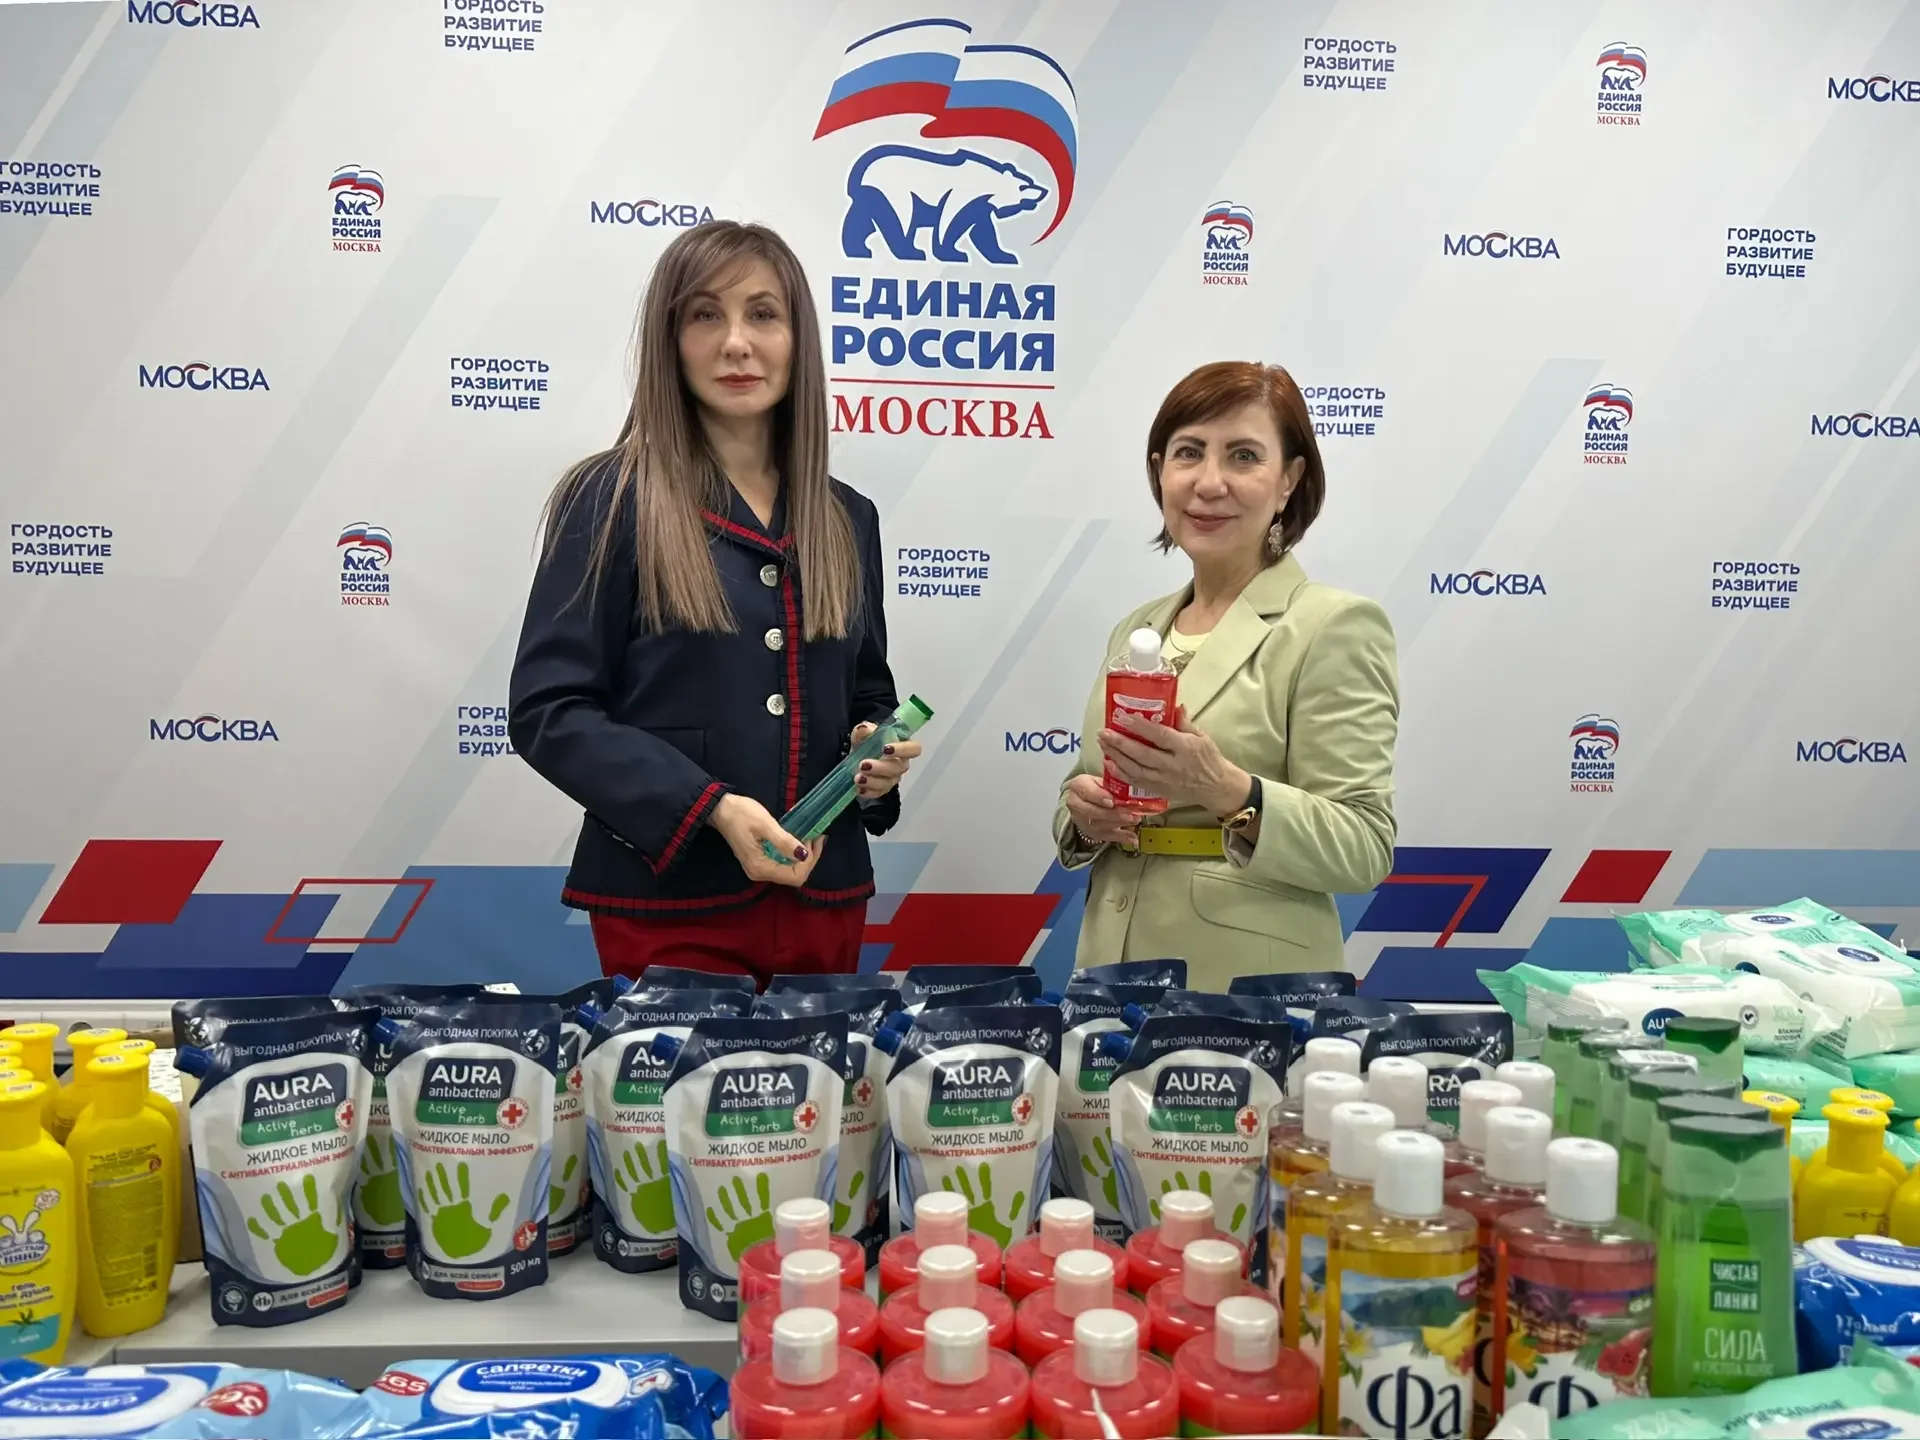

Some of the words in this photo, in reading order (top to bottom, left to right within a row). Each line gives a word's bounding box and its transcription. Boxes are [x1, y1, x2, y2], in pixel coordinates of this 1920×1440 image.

[127, 0, 261, 29] МОСКВА
[444, 15, 543, 33] РАЗВИТИЕ
[444, 34, 535, 53] БУДУЩЕЕ
[1304, 37, 1397, 54] ГОРДОСТЬ
[1303, 55, 1395, 72] РАЗВИТИЕ
[1303, 74, 1387, 92] БУДУЩЕЕ
[1827, 75, 1920, 103] МОСКВ
[1597, 92, 1642, 105] ЕДИНАЯ
[1597, 102, 1642, 112] РОССИЯ
[1596, 113, 1641, 126] МОСКВА
[0, 161, 102, 179] ГОРДОСТЬ
[0, 181, 100, 197] РАЗВИТИЕ
[0, 200, 92, 218] БУДУЩЕЕ
[591, 199, 715, 227] МОСКВА
[332, 217, 381, 228] ЕДИНАЯ
[332, 227, 381, 239] РОССИЯ
[1727, 227, 1816, 244] ГОРДОСТЬ
[332, 242, 382, 253] МОСКВА
[1443, 232, 1561, 259] МОСКВА
[1726, 245, 1814, 261] РАЗВИТИЕ
[1203, 251, 1249, 264] ЕДИНАЯ
[1203, 261, 1249, 272] РОССИЯ
[1726, 262, 1806, 279] БУДУЩЕЕ
[1203, 273, 1249, 286] МОСКВА
[831, 276, 1056, 321] ЕДИНАЯ
[831, 325, 1055, 372] РОССИЯ
[450, 357, 550, 374] ГОРДОСТЬ
[139, 362, 270, 391] МОСКВА
[451, 376, 548, 392] РАЗВИТИЕ
[1303, 387, 1386, 401] ОРДОСТЬ
[451, 394, 541, 412] БУДУЩЕЕ
[830, 395, 1055, 439] МОСКВА
[1307, 404, 1384, 420] АЗВИТИЕ
[1313, 422, 1376, 438] ДУЩЕЕ
[1811, 412, 1920, 438] МОСКВА
[1584, 432, 1629, 444] ЕДИНАЯ
[1584, 441, 1628, 452] РОССИЯ
[1583, 452, 1627, 465] МОСКВА
[11, 523, 113, 540] ГОРДОСТЬ
[11, 542, 112, 557] РАЗВИТИЕ
[898, 548, 991, 563] ГОРДОСТЬ
[12, 560, 104, 577] БУДУЩЕЕ
[898, 565, 989, 579] РАЗВИТИЕ
[1713, 561, 1801, 577] ГОРДОСТЬ
[340, 572, 389, 583] ЕДИНАЯ
[1430, 570, 1547, 596] МОСКВА
[1712, 578, 1798, 593] РАЗВИТИЕ
[340, 582, 390, 593] РОССИЯ
[898, 583, 981, 599] БУДУЩЕЕ
[341, 596, 390, 606] МОСКВА
[1711, 595, 1790, 611] БУДУЩЕЕ
[458, 706, 507, 722] ГОРД
[150, 715, 279, 743] МОСКВА
[458, 724, 506, 737] РАЗВ
[459, 741, 518, 757] БУДУ
[1005, 729, 1081, 755] МОСК
[1796, 738, 1908, 764] МОСКВА
[1570, 770, 1615, 780] РОССИЯ
[1571, 761, 1615, 773] ЕДИНАЯ
[1570, 783, 1614, 793] МОСКВА
[1281, 992, 1322, 1004] ПОКУПКА
[623, 1011, 675, 1022] ВЫГОДНАЯ
[1075, 1004, 1121, 1014] ВЫГОДНАЯ
[424, 1027, 479, 1039] ВЫГОДНАЯ
[480, 1028, 519, 1039] ПОКУПКА
[925, 1029, 977, 1042] ВЫГОДНАЯ
[978, 1029, 1022, 1040] ПОКУПКА
[234, 1043, 295, 1057] ВЫГОДНАЯ
[296, 1031, 343, 1050] ПОКУПКА
[705, 1038, 761, 1050] ВЫГОДНАЯ
[762, 1035, 808, 1049] ПОКУПКА
[1151, 1035, 1203, 1049] ВЫГОДНАЯ
[1204, 1036, 1250, 1047] ПОКУПКА
[1380, 1038, 1428, 1052] ВЫГОДНАЯ
[1429, 1035, 1477, 1048] ПОКУПКА
[430, 1064, 502, 1085] AURA
[942, 1065, 1011, 1085] AURA
[1165, 1072, 1236, 1092] AURA
[253, 1073, 333, 1103] AURA
[721, 1072, 794, 1094] AURA
[1429, 1074, 1462, 1093] RA
[429, 1085, 501, 1099] antibacterial
[942, 1086, 1013, 1099] antibacterial
[253, 1092, 336, 1117] antibacterial
[428, 1102, 466, 1114] Active
[554, 1098, 578, 1112] ЫЛО
[721, 1095, 796, 1109] antibacterial
[1083, 1098, 1110, 1111] ЖИД
[1164, 1094, 1237, 1107] antibacterial
[458, 1112, 486, 1124] herb
[841, 1110, 864, 1125] ЫЛО
[943, 1105, 978, 1117] Active
[972, 1112, 1000, 1124] herb
[1165, 1111, 1201, 1123] Active
[257, 1120, 297, 1134] Active
[720, 1114, 758, 1126] Active
[751, 1120, 781, 1134] herb
[1195, 1120, 1223, 1133] herb
[290, 1123, 322, 1137] herb
[606, 1122, 665, 1135] АНТИБАКТЕРИАЛЬ
[471, 1132, 510, 1145] МЫЛО
[932, 1132, 985, 1147] ЖИДКОЕ
[989, 1129, 1024, 1144] МЫЛО
[1152, 1136, 1207, 1152] ЖИДКОЕ
[1210, 1139, 1249, 1154] МЫЛО
[247, 1144, 309, 1167] ЖИДКОЕ
[312, 1135, 348, 1154] МЫЛО
[708, 1140, 765, 1157] ЖИДКОЕ
[769, 1138, 807, 1153] МЫЛО
[510, 1260, 526, 1275] 500
[1712, 1262, 1758, 1281] ЧИСТАЯ
[1713, 1291, 1758, 1311] ЛИНИЯ
[1704, 1327, 1767, 1362] СИЛА
[1366, 1365, 1462, 1439] Фа
